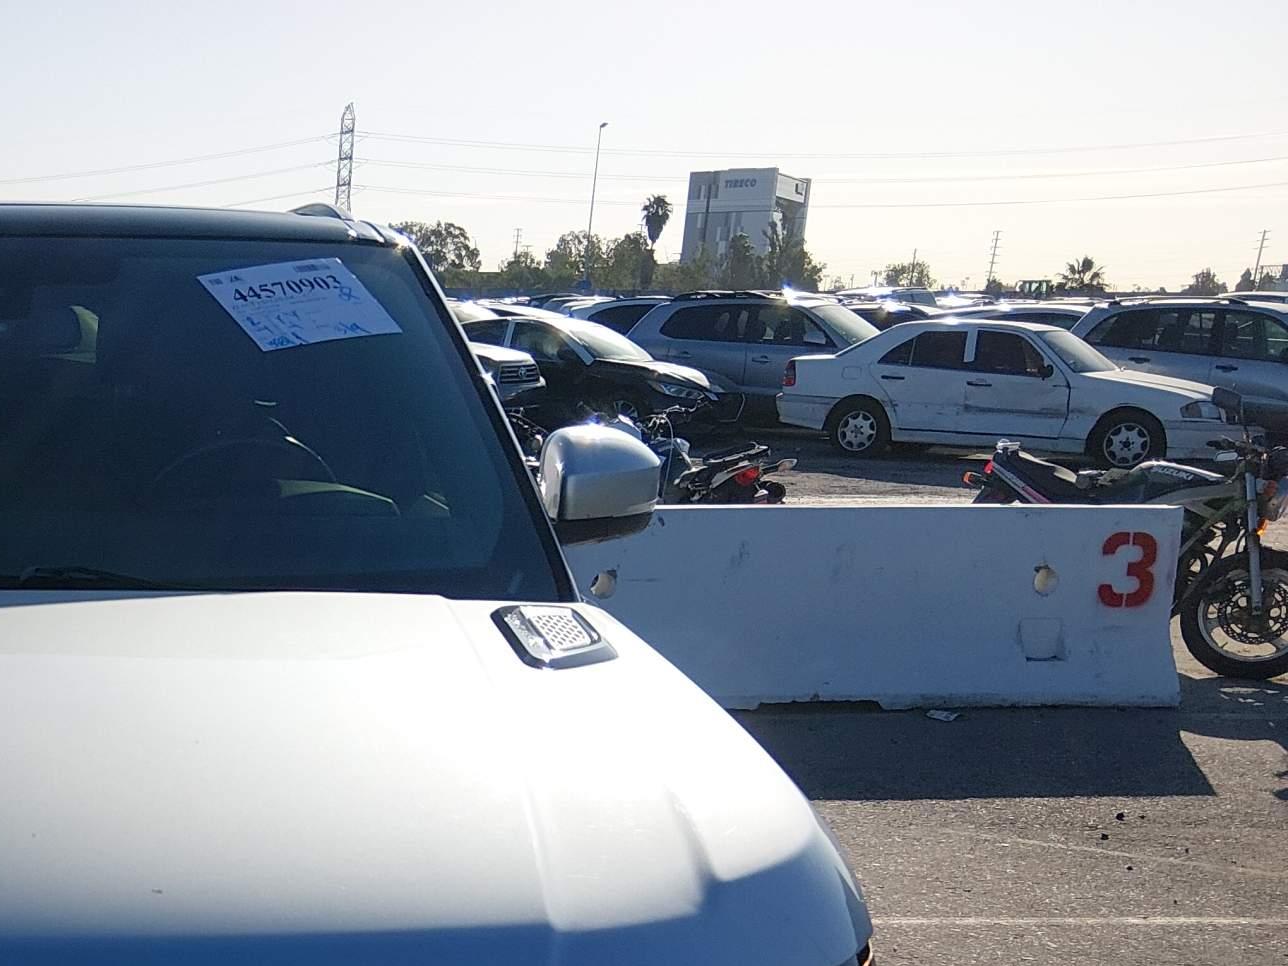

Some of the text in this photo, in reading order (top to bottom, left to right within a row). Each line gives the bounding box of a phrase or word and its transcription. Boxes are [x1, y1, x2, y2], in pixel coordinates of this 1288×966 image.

[232, 273, 342, 303] 44570903
[1150, 465, 1195, 481] SUZUKI
[1097, 531, 1158, 609] 3
